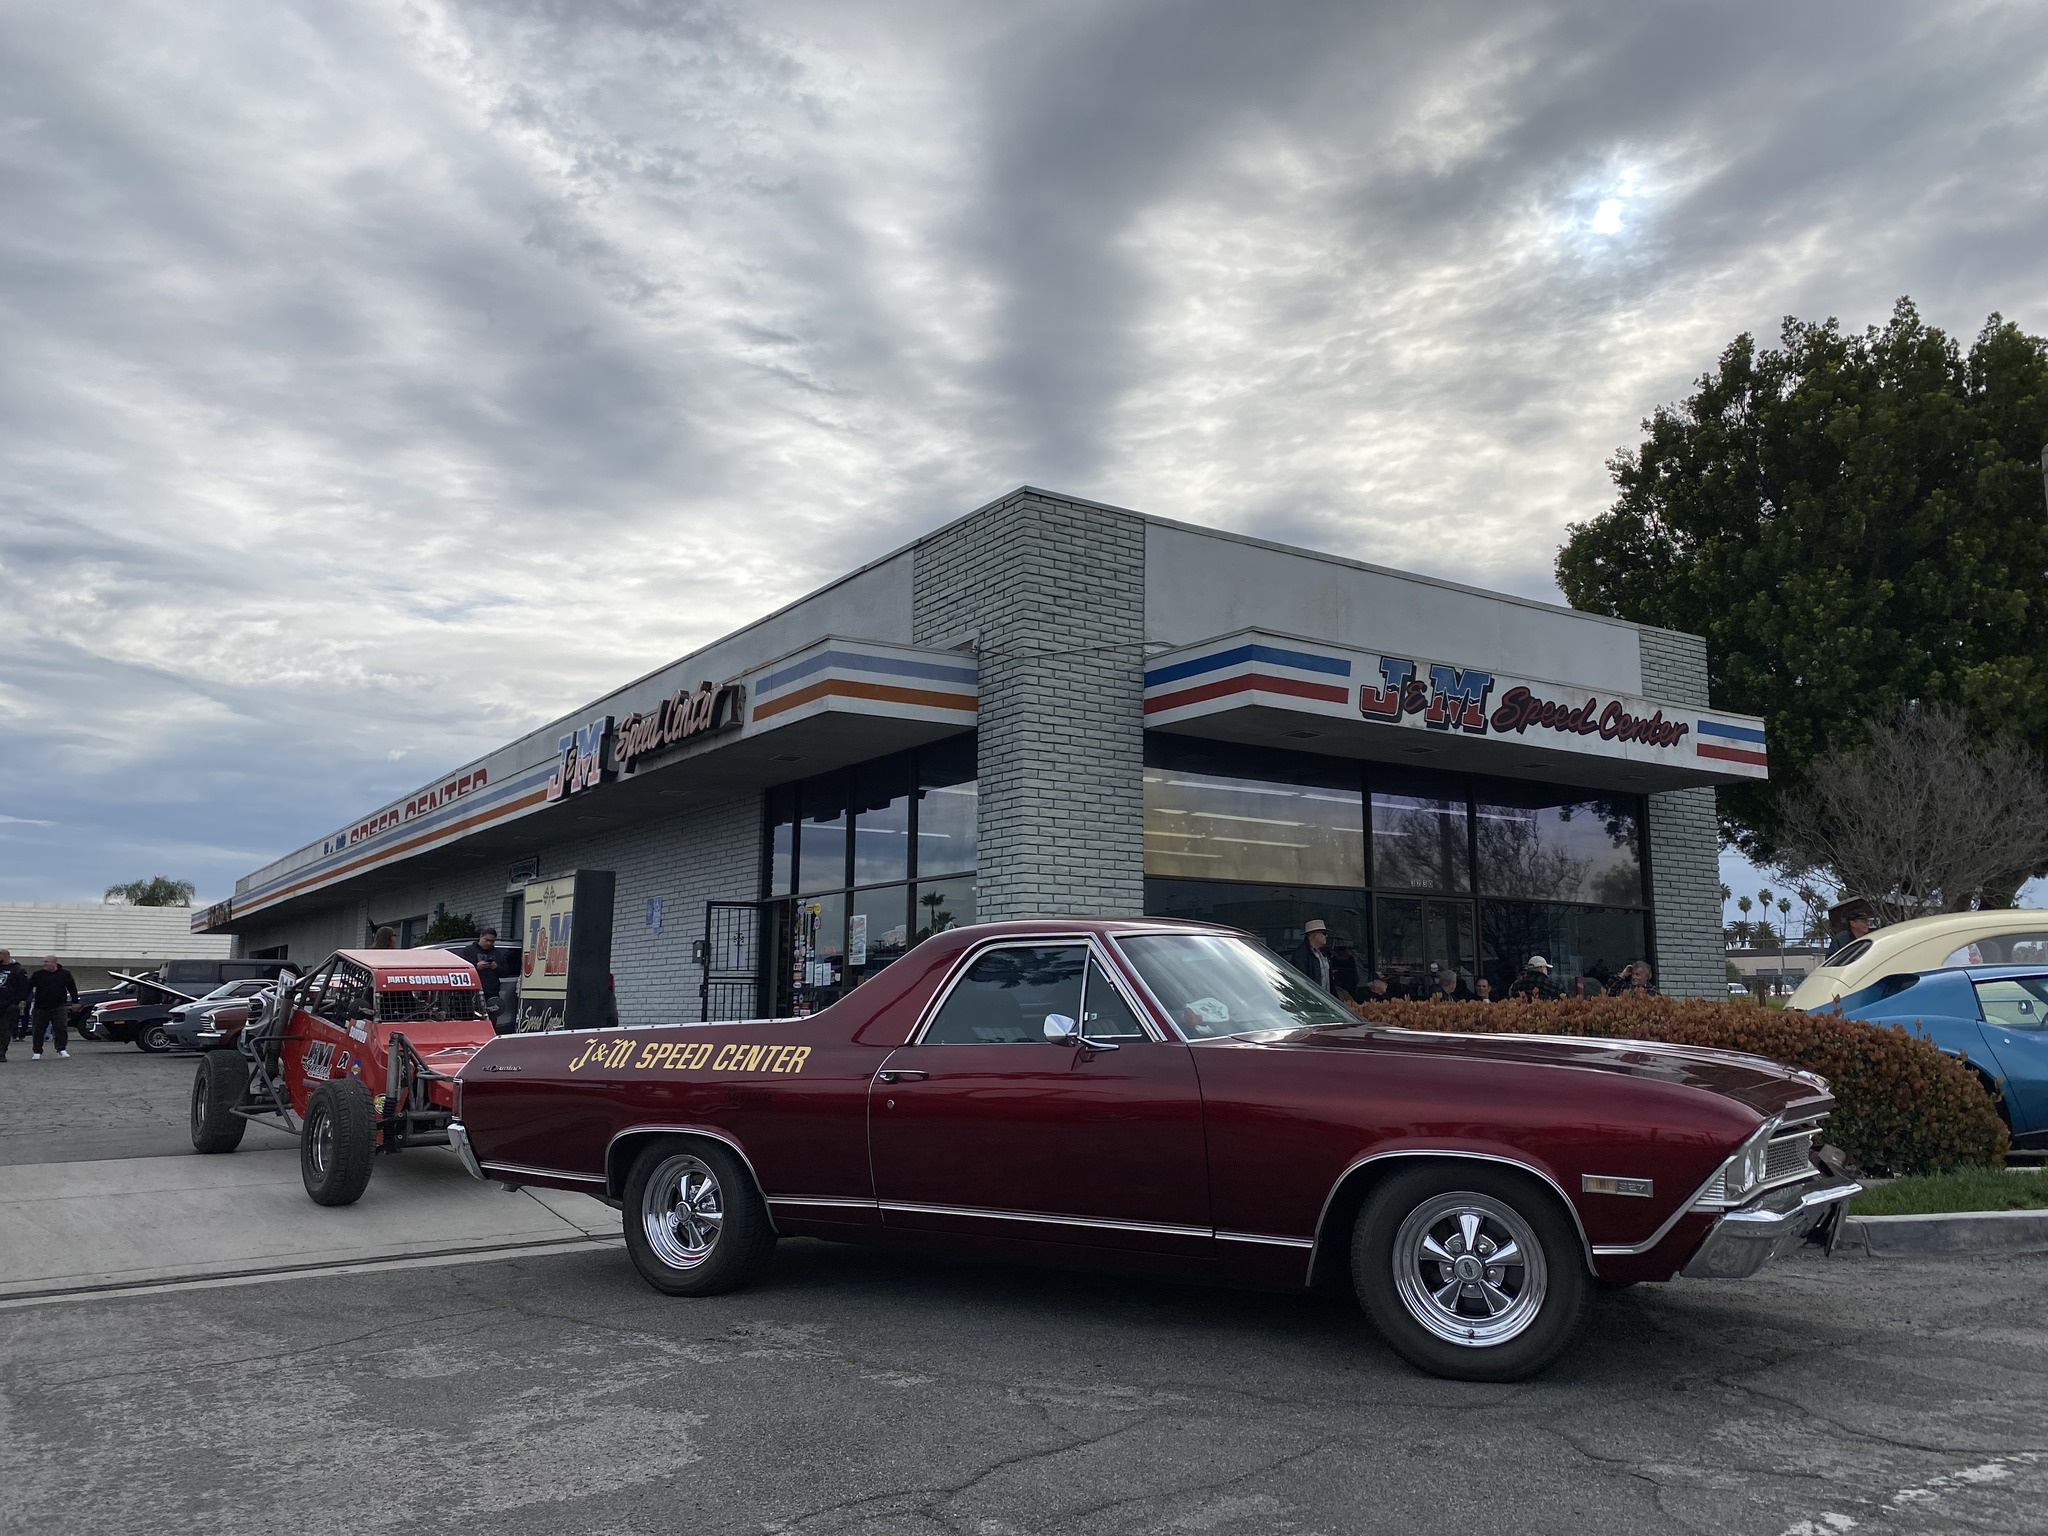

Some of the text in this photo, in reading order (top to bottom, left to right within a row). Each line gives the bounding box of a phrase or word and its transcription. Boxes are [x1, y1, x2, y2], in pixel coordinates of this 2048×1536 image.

[1359, 655, 1689, 747] J&M Speed Center
[547, 683, 723, 802] J&M Speed Center
[523, 912, 573, 978] J&M
[387, 974, 469, 985] MATT SOMODY 314
[521, 1005, 544, 1032] Speed
[568, 1038, 812, 1074] J&M SPEED CENTER
